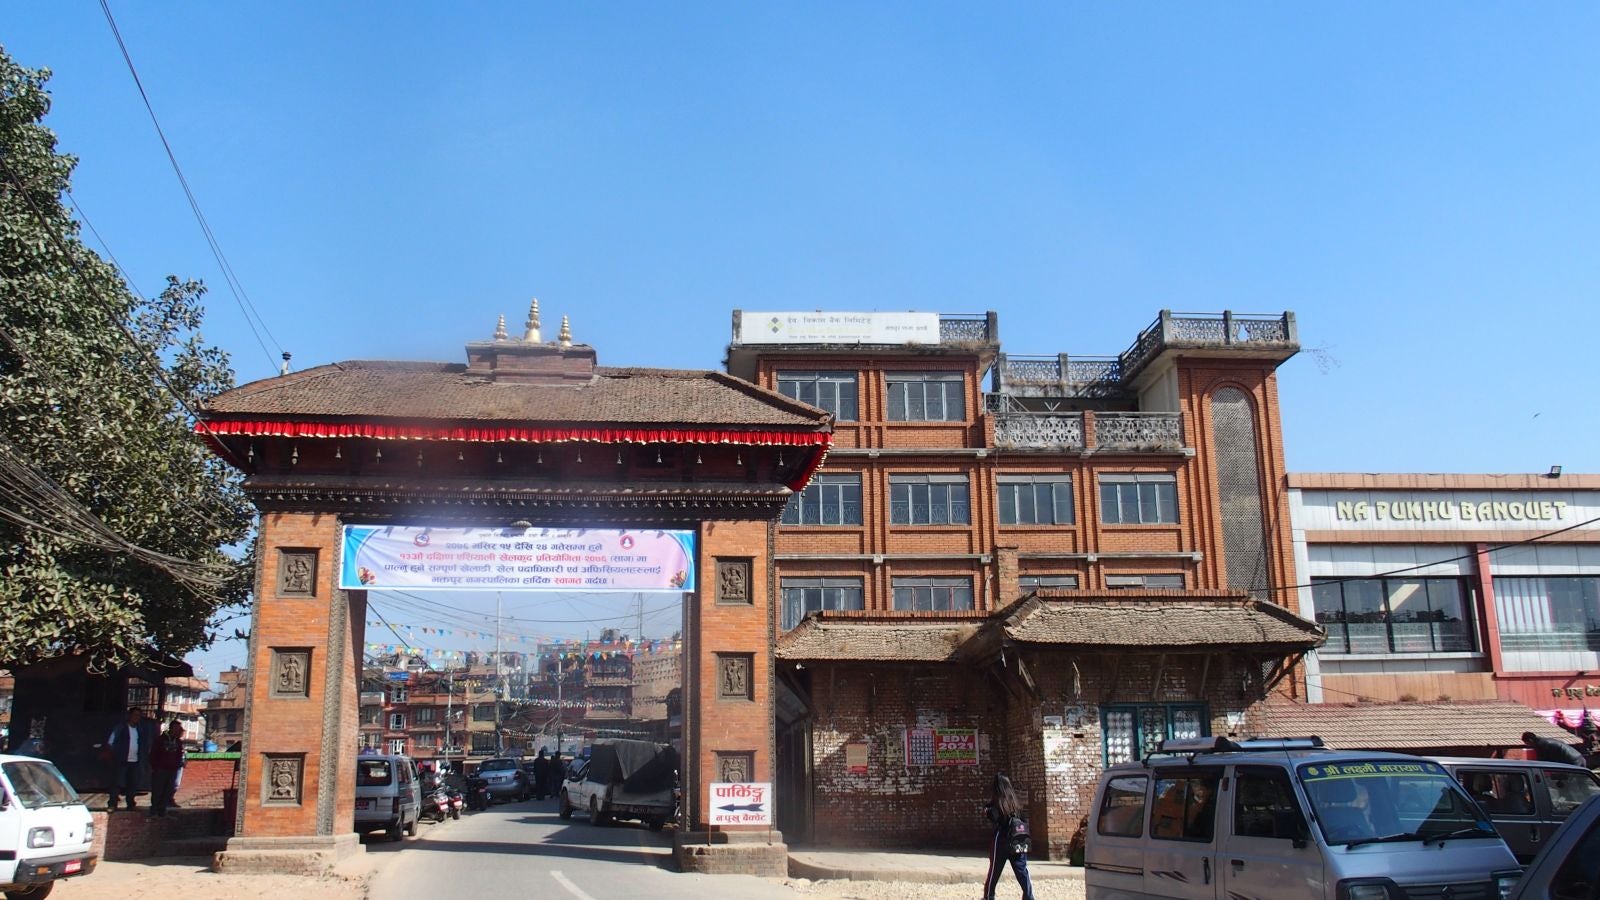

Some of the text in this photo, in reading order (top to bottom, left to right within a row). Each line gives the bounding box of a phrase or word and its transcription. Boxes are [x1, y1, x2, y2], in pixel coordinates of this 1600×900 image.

[1336, 501, 1568, 522] NA PUKHU BANQUET
[515, 541, 533, 550] देखि
[551, 542, 585, 551] गतेसम्म
[588, 542, 603, 552] हुने
[427, 551, 454, 561] दक्षिण
[536, 552, 581, 562] प्रतियोगिता
[496, 564, 514, 573] खेल
[518, 564, 563, 573] पदाधिकारी
[554, 577, 582, 585] स्वागत
[1322, 764, 1341, 777] श्री
[1377, 764, 1424, 773] नारायण
